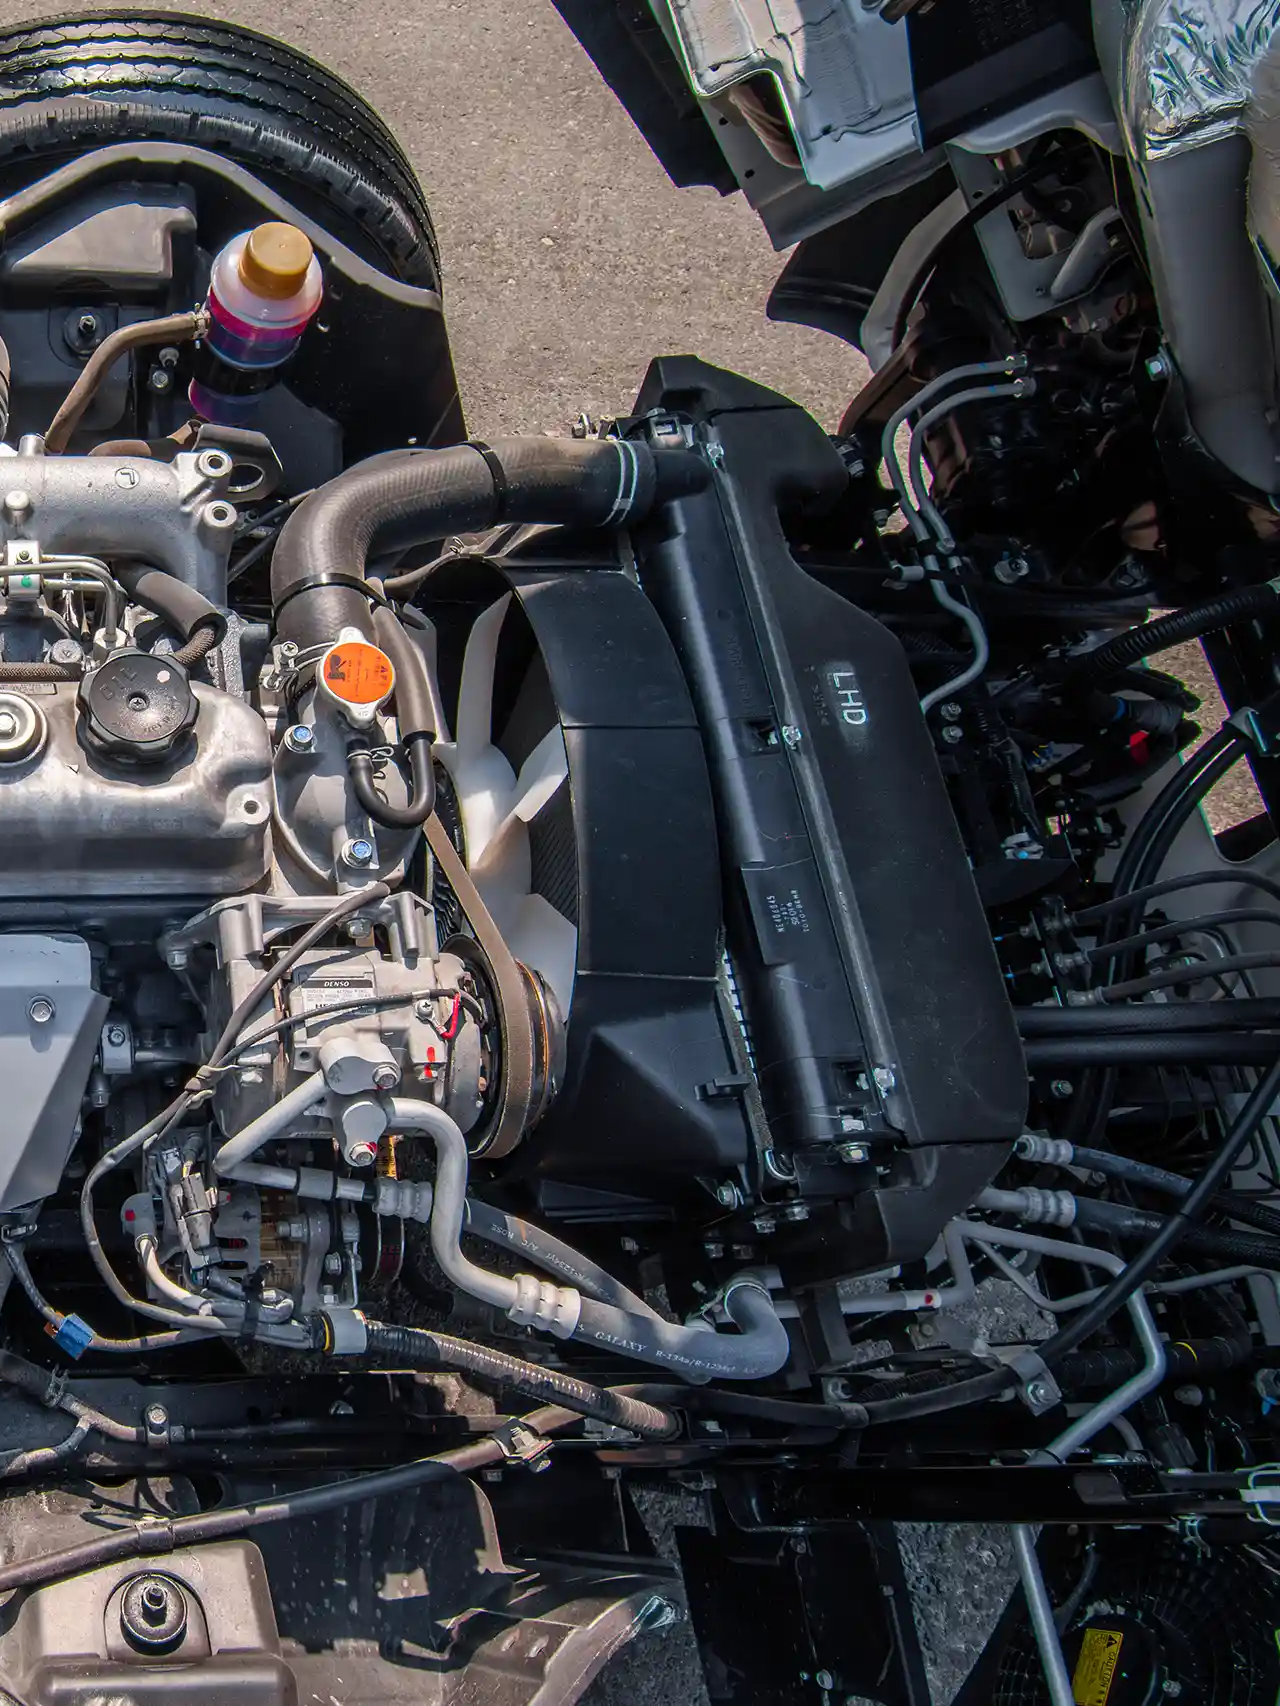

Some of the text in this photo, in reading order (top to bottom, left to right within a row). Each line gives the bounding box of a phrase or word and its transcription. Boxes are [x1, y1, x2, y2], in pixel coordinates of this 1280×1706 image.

[833, 672, 867, 725] LHD
[521, 1239, 539, 1252] A/C
[595, 1331, 648, 1352] GALAXY
